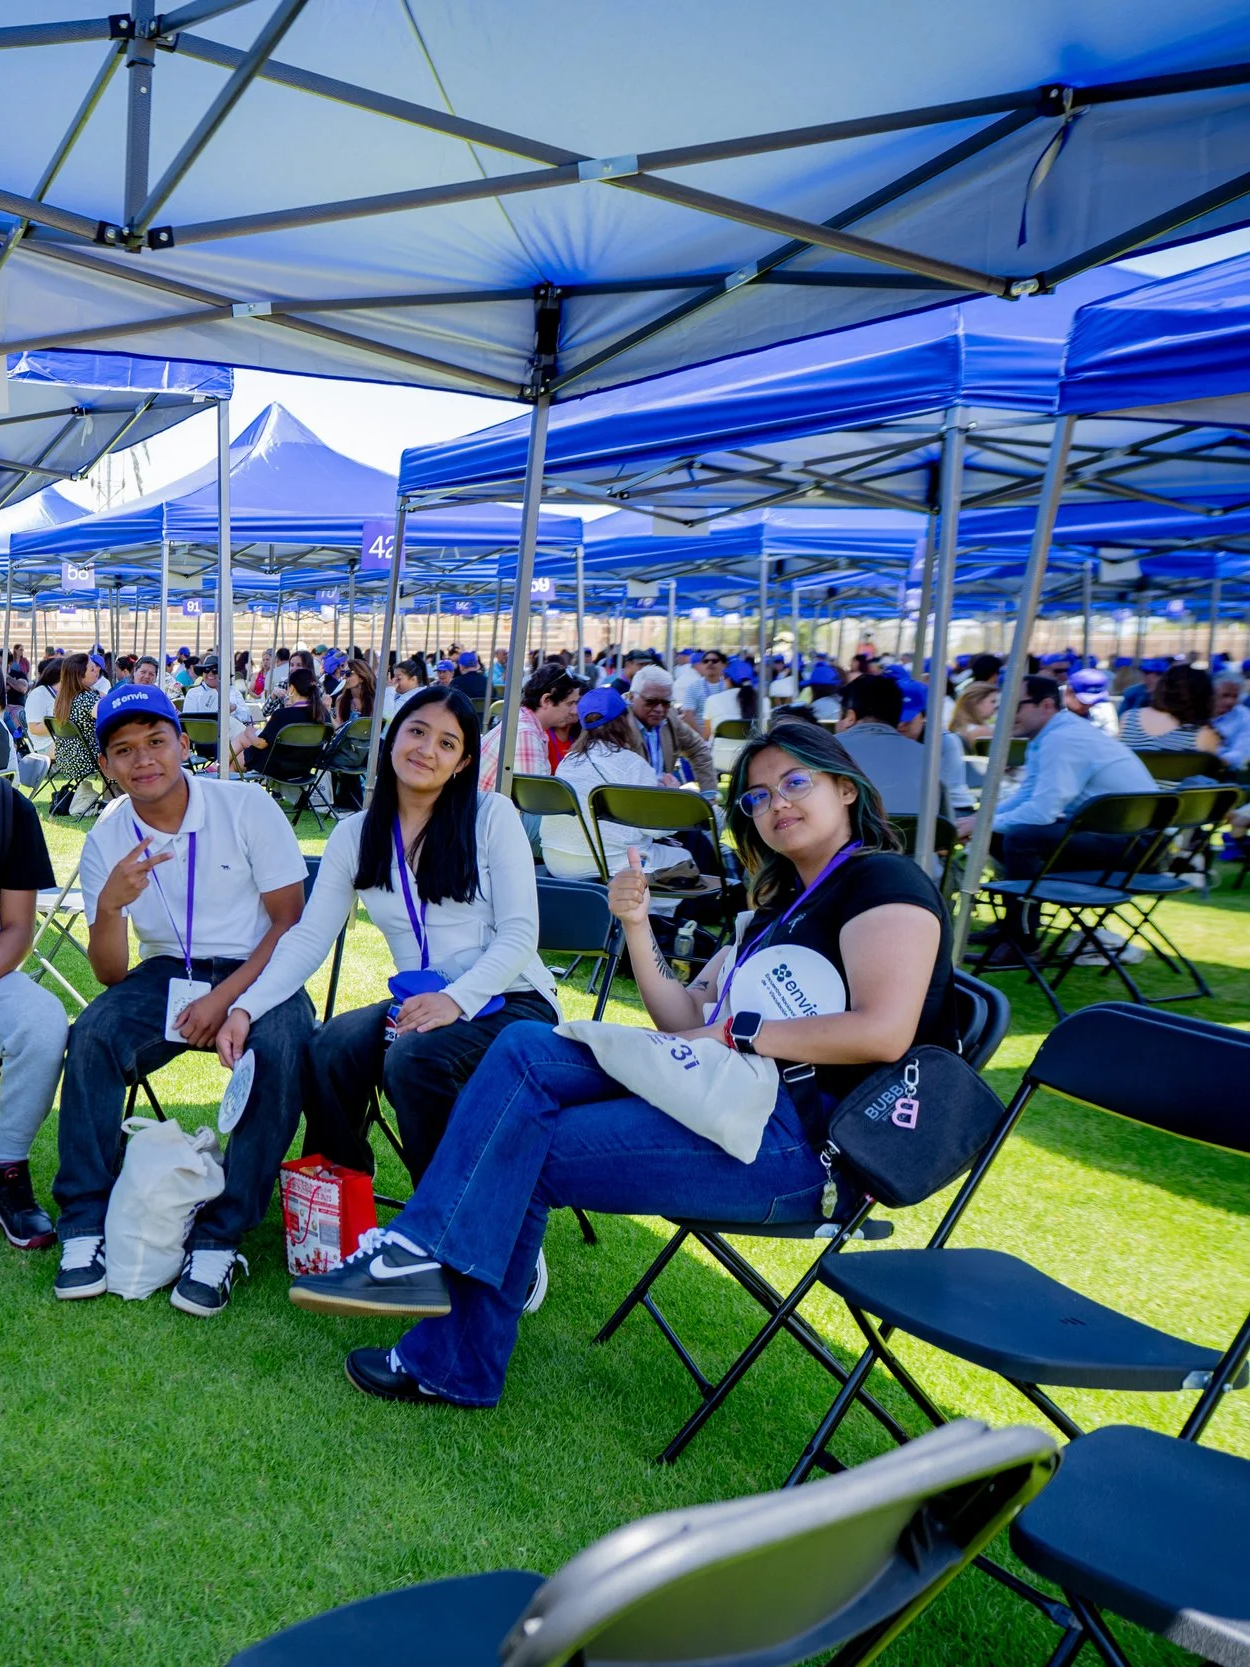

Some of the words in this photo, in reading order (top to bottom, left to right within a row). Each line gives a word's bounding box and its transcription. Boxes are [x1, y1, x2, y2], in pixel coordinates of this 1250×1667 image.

[187, 600, 201, 613] 91
[121, 691, 149, 703] envis
[785, 980, 818, 1017] envis
